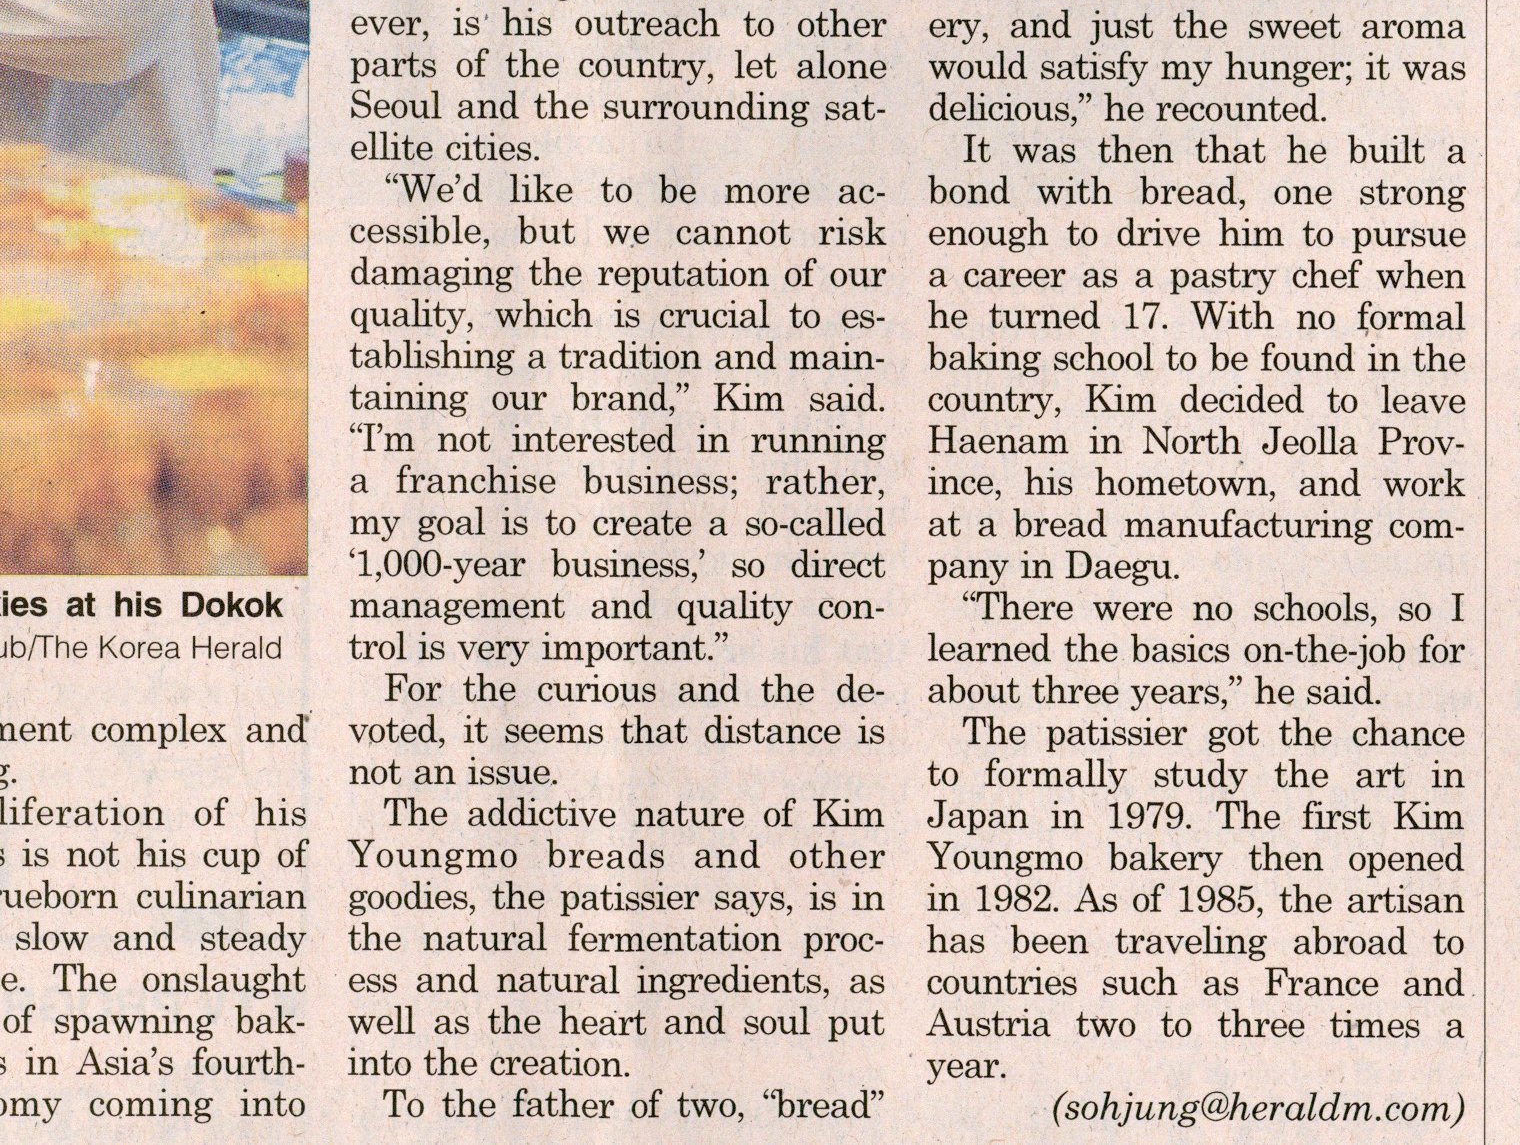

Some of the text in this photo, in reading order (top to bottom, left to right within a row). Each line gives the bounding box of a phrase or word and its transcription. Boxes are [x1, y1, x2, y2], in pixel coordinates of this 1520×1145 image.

[928, 216, 1467, 255] enough to drive him to pursue
[350, 255, 887, 294] damaging the reputation of our
[928, 424, 1465, 456] Haenam in North Jeolla Prov-
[66, 592, 96, 618] at
[114, 590, 163, 618] his
[181, 590, 284, 619] Dokok
[349, 589, 885, 627] management and quality con-
[99, 634, 181, 660] Korea
[192, 635, 282, 660] Herald
[91, 712, 228, 750] complex
[245, 709, 307, 744] and
[926, 799, 1465, 836] Japan in 1979. The first Kim
[346, 838, 886, 876] Youngmo breads and other
[926, 923, 1465, 962] has been traveling abroad to
[2, 1003, 37, 1034] of
[54, 1005, 216, 1042] spawning
[234, 1004, 306, 1035] bak-
[1052, 1090, 1466, 1130] (sohjung@heraldm.com)
